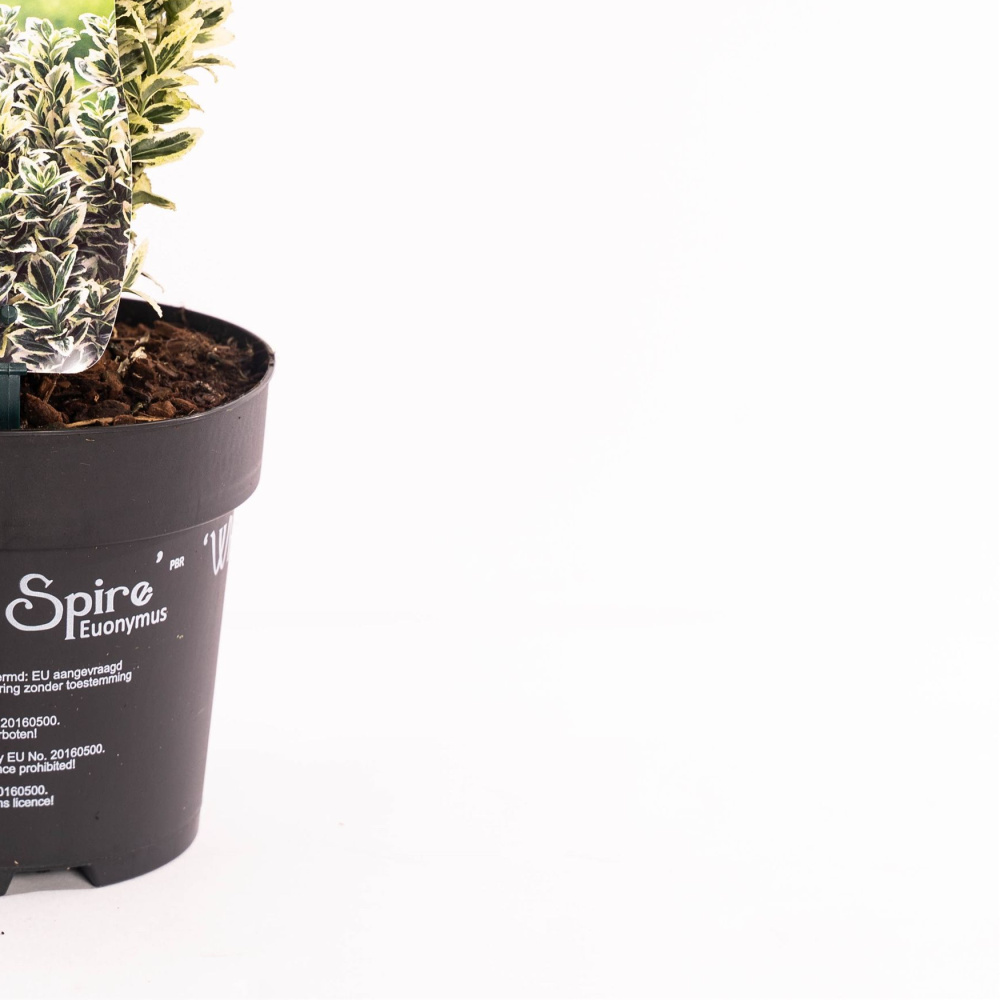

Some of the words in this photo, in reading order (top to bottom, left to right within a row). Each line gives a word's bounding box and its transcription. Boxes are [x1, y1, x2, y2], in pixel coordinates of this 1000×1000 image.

[169, 555, 186, 572] PBR
[79, 606, 169, 639] Euonymus
[32, 670, 49, 680] EU
[53, 660, 123, 680] aangevraagd
[24, 682, 63, 692] zonder
[66, 672, 132, 690] toestemming
[1, 715, 60, 728] 20160500.
[7, 752, 24, 762] EU
[28, 751, 46, 762] No.
[50, 744, 105, 761] 20160500.
[19, 760, 75, 775] prohibited!
[13, 796, 54, 807] licence!
